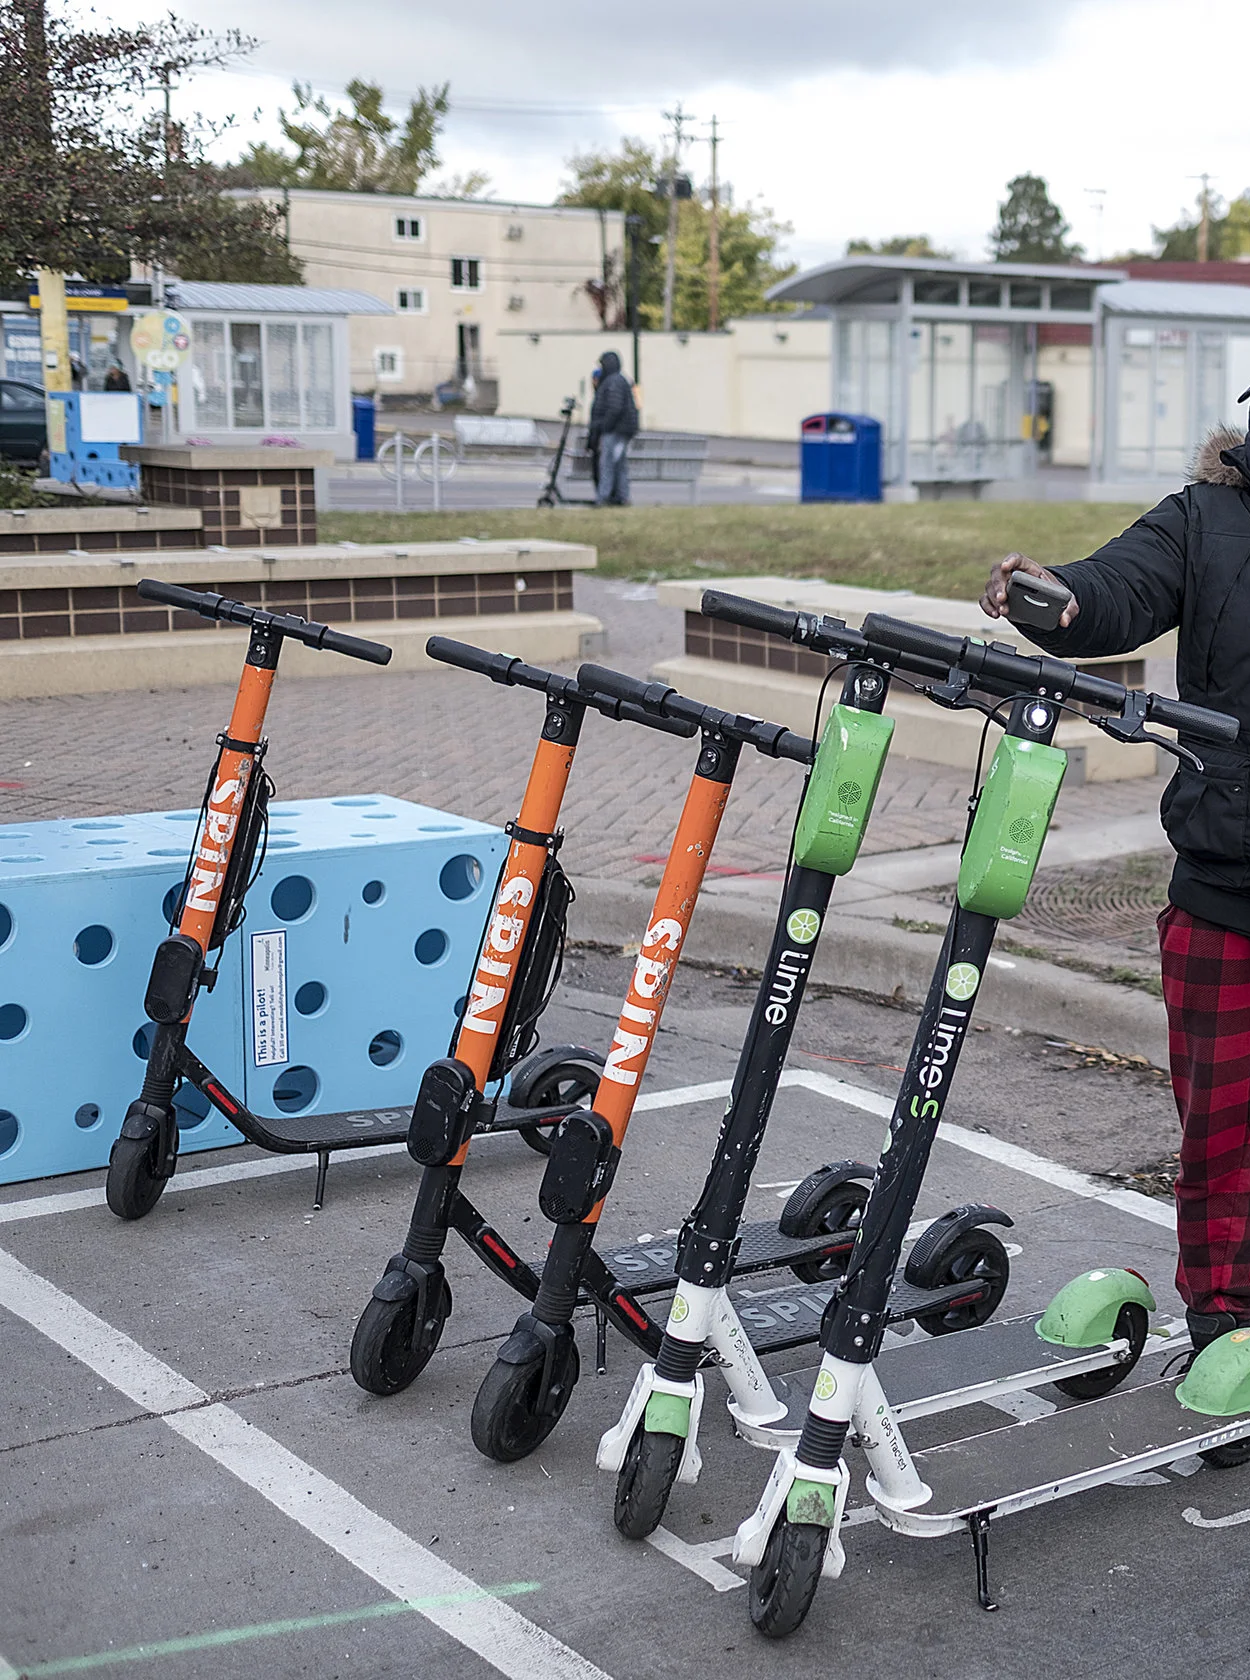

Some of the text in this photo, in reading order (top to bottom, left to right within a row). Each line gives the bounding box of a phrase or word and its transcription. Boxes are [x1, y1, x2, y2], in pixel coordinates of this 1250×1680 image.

[462, 876, 534, 1035] SPIN
[603, 917, 683, 1086] SPIN
[764, 949, 808, 1026] Lime
[257, 989, 268, 1017] pilot!
[258, 1040, 267, 1061] This
[613, 1247, 677, 1272] SP
[880, 1416, 893, 1437] GPS
